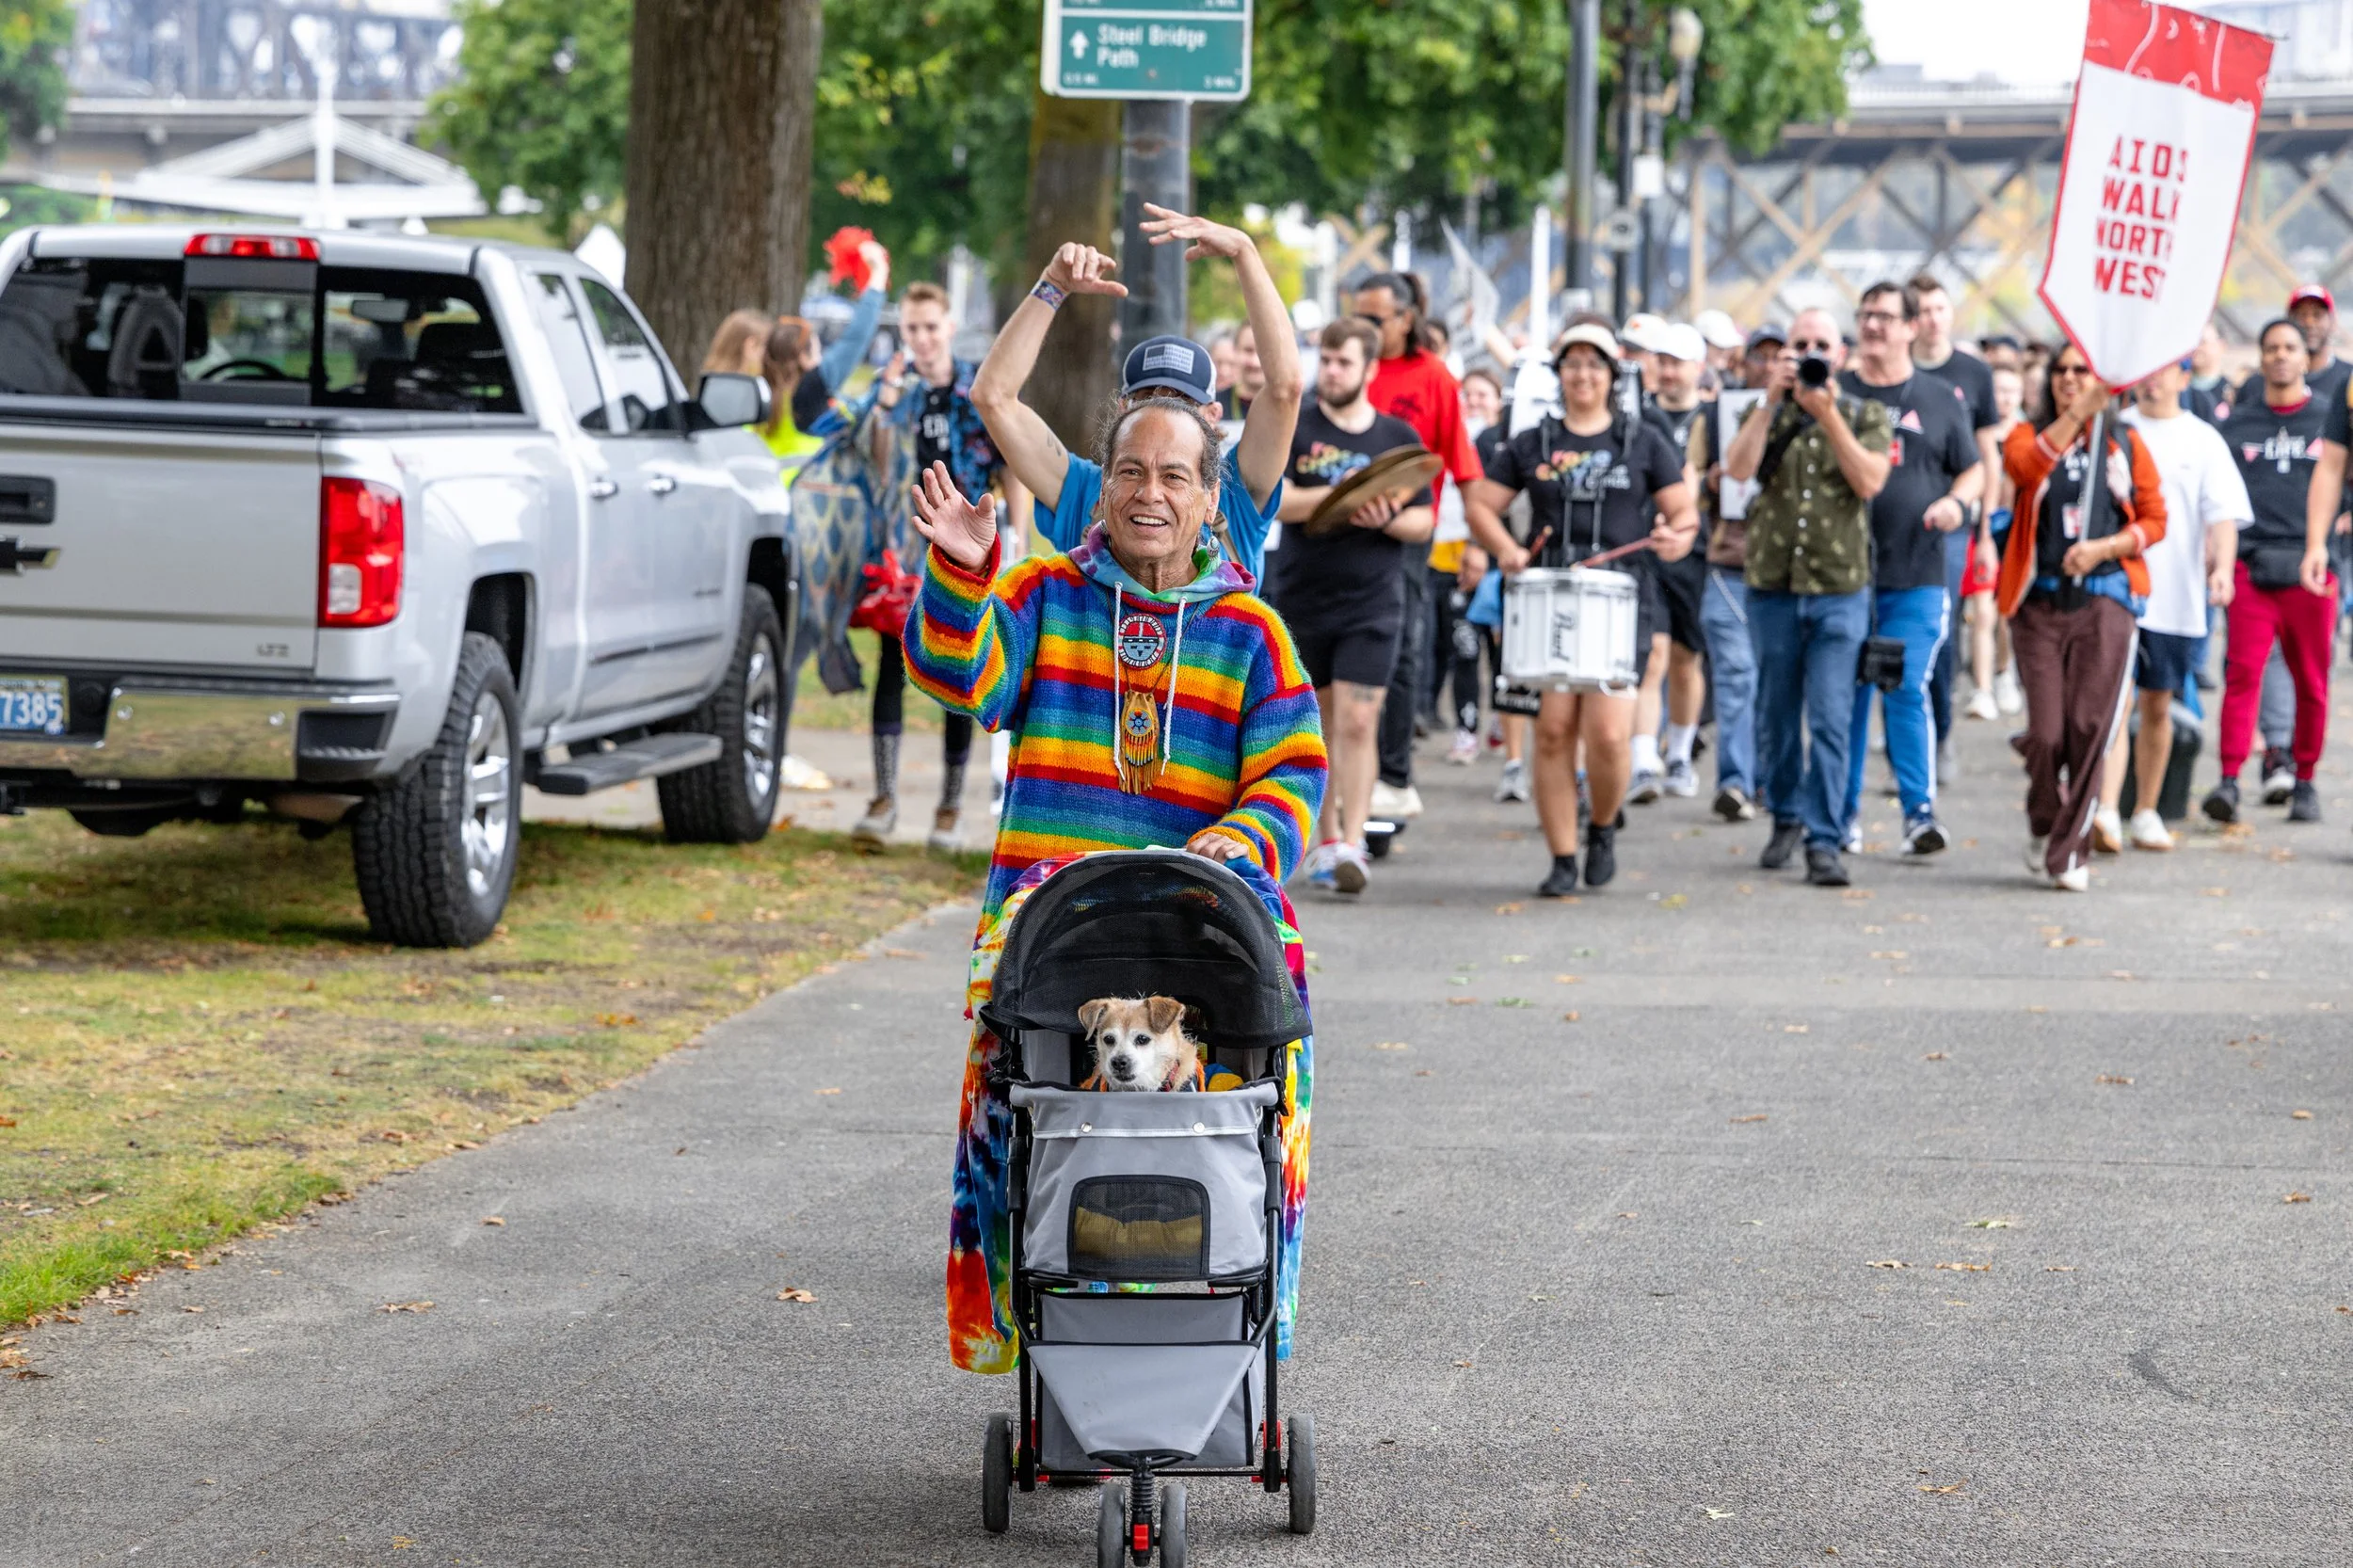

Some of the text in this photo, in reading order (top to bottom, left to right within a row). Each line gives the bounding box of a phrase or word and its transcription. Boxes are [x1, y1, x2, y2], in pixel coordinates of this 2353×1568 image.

[1097, 24, 1208, 53] Steel Bridge
[1097, 47, 1139, 68] Path
[2094, 256, 2167, 302] WES
[0, 692, 63, 726] 7385
